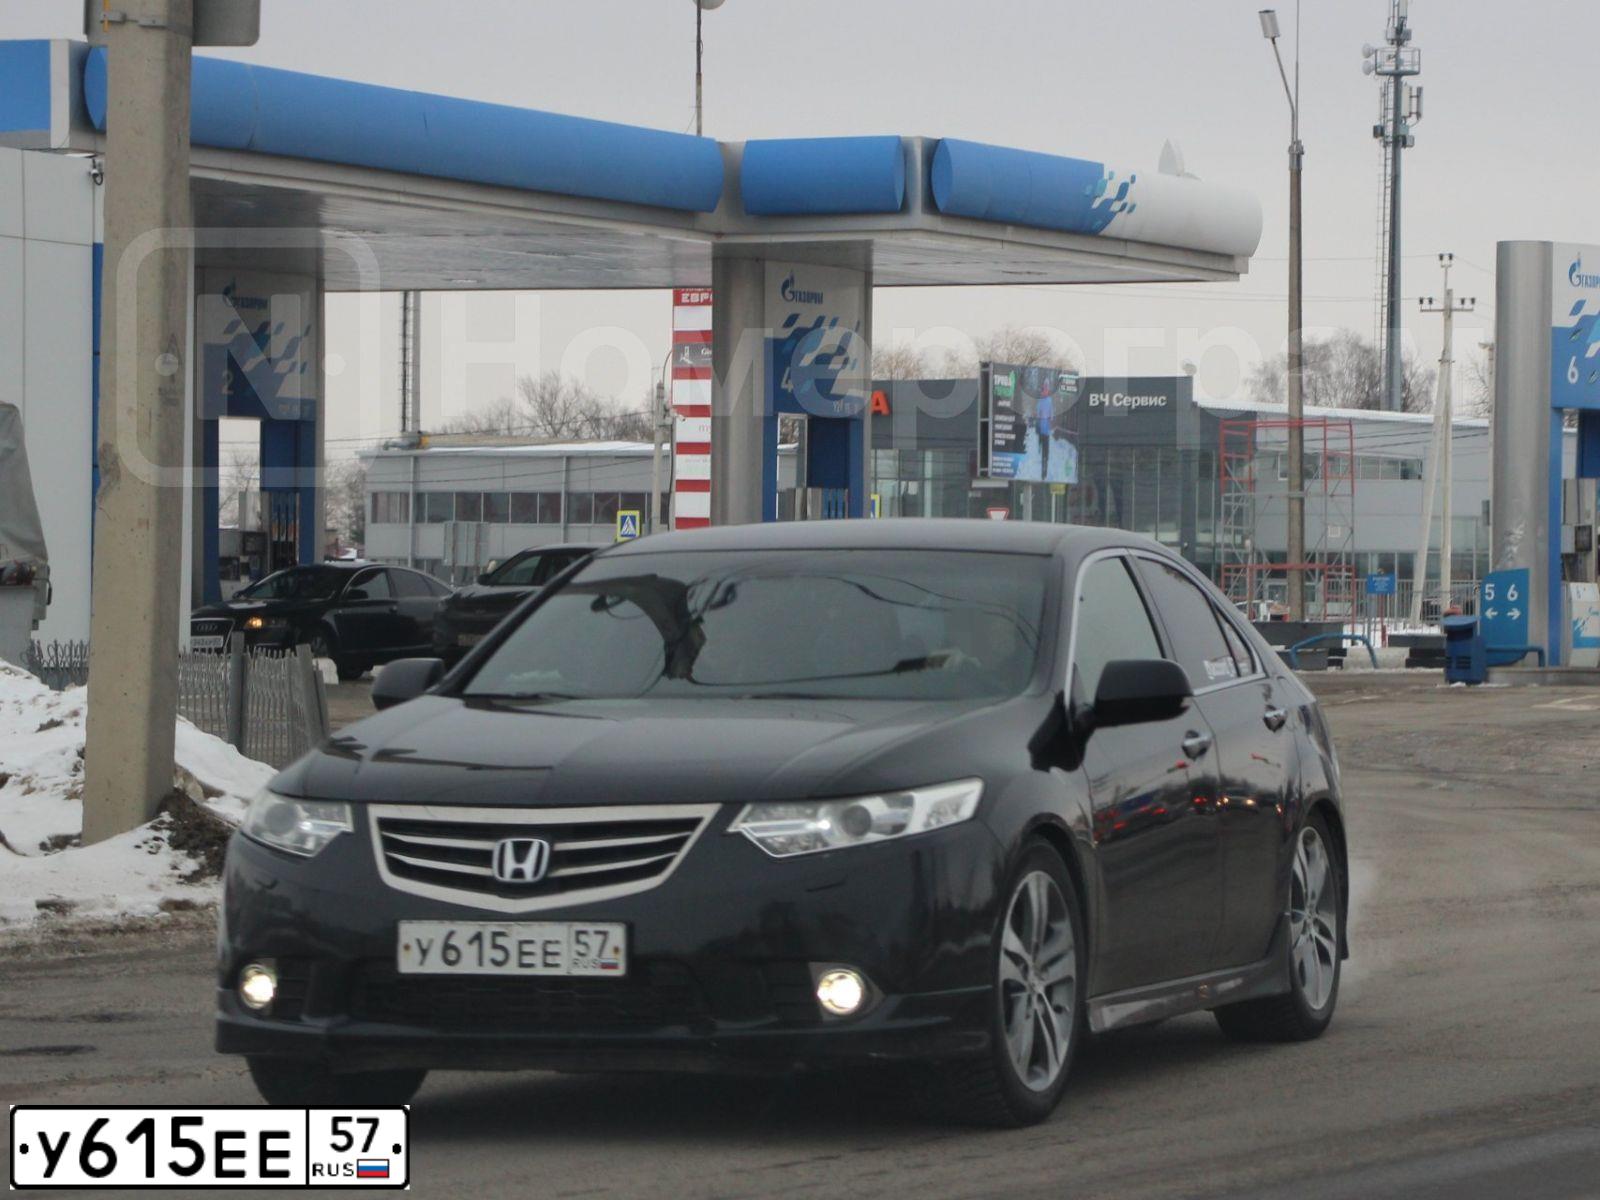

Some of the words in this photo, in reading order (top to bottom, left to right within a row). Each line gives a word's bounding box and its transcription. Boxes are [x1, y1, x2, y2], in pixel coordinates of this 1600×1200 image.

[221, 370, 234, 395] 2
[781, 366, 795, 393] 4
[1567, 356, 1579, 385] 6
[1089, 392, 1110, 407] ВЧ
[1112, 392, 1168, 409] Сервис
[1485, 583, 1496, 602] 5
[1506, 583, 1519, 602] 6
[415, 930, 562, 970] У615ЕЕ
[574, 930, 610, 959] 57
